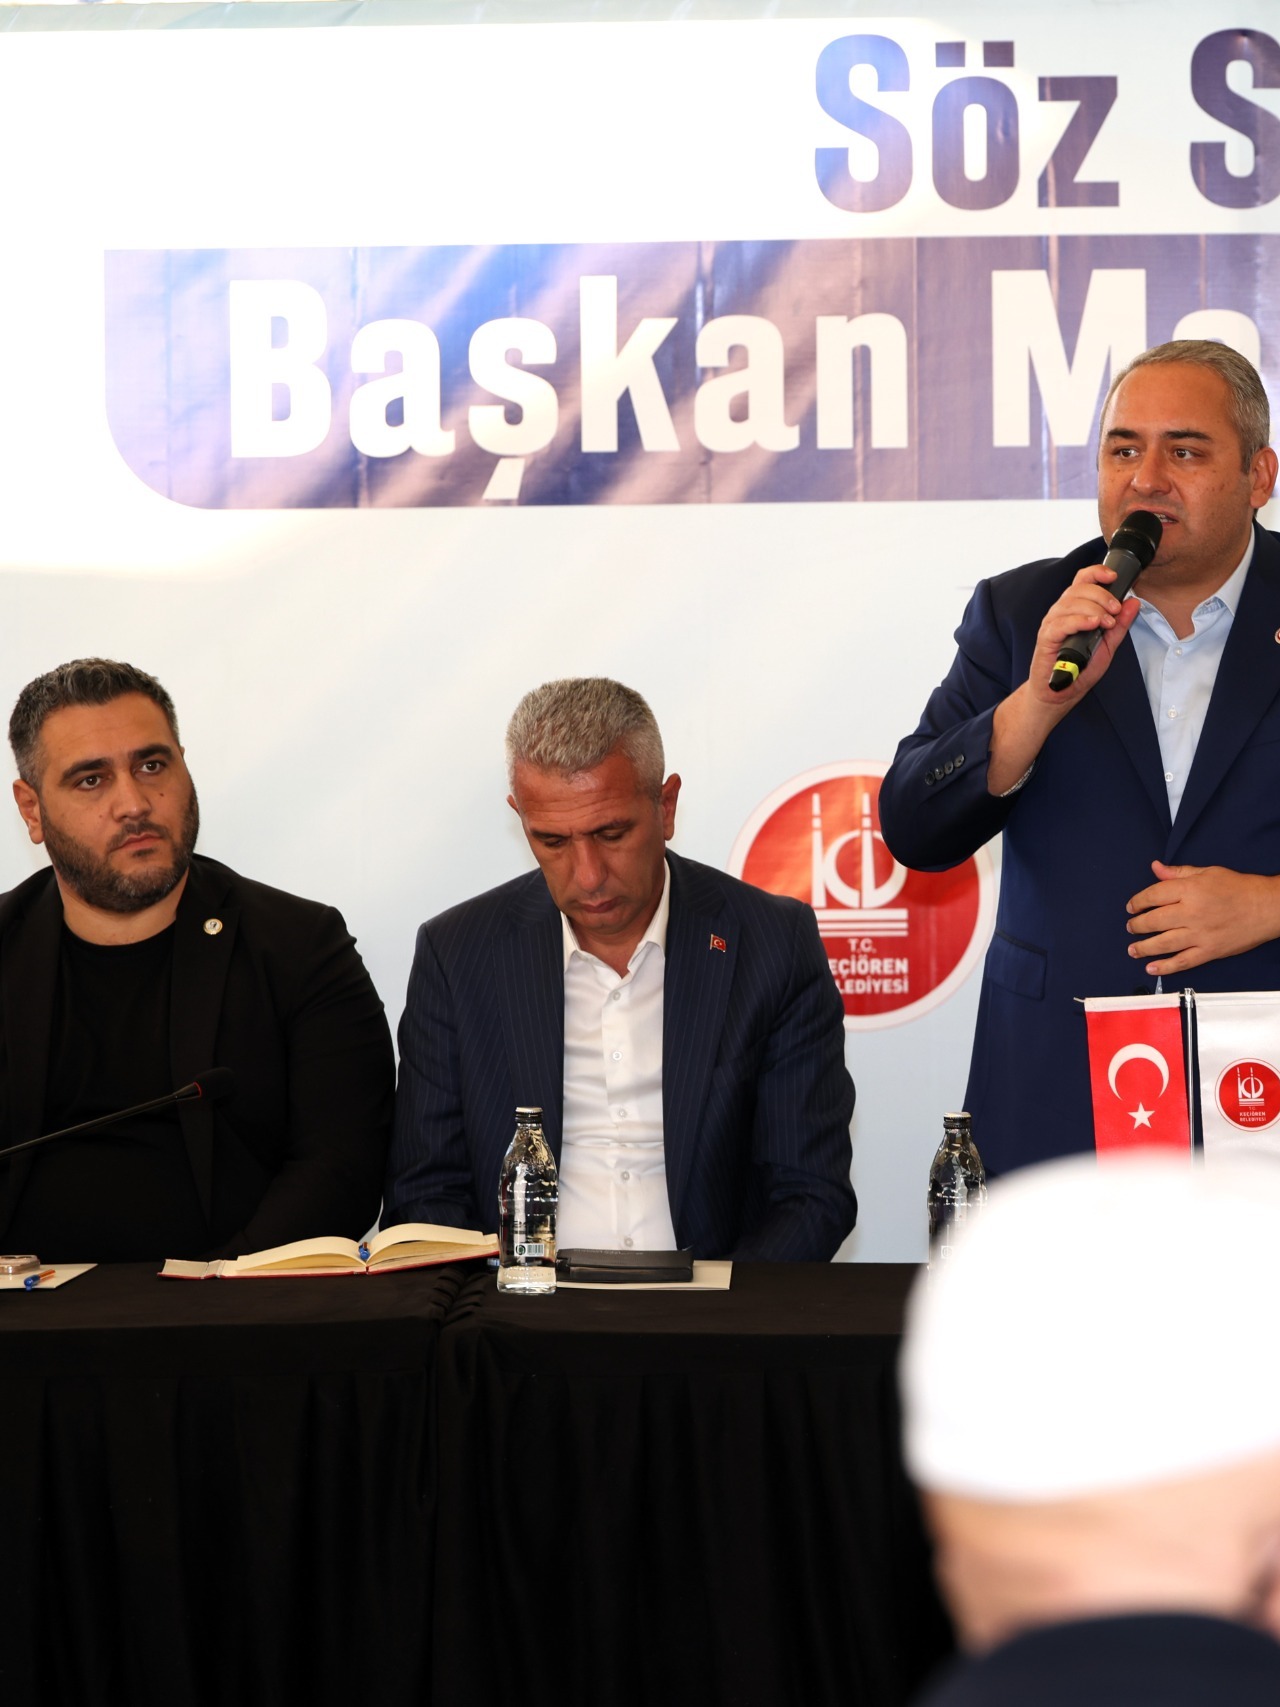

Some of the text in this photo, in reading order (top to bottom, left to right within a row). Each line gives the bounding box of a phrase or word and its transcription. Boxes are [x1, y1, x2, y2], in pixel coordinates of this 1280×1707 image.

[814, 33, 1120, 213] Söz
[228, 274, 911, 502] Başkan
[847, 937, 877, 954] T.C.
[827, 954, 909, 979] EÇİÖREN
[834, 974, 909, 995] LEDİYESİ
